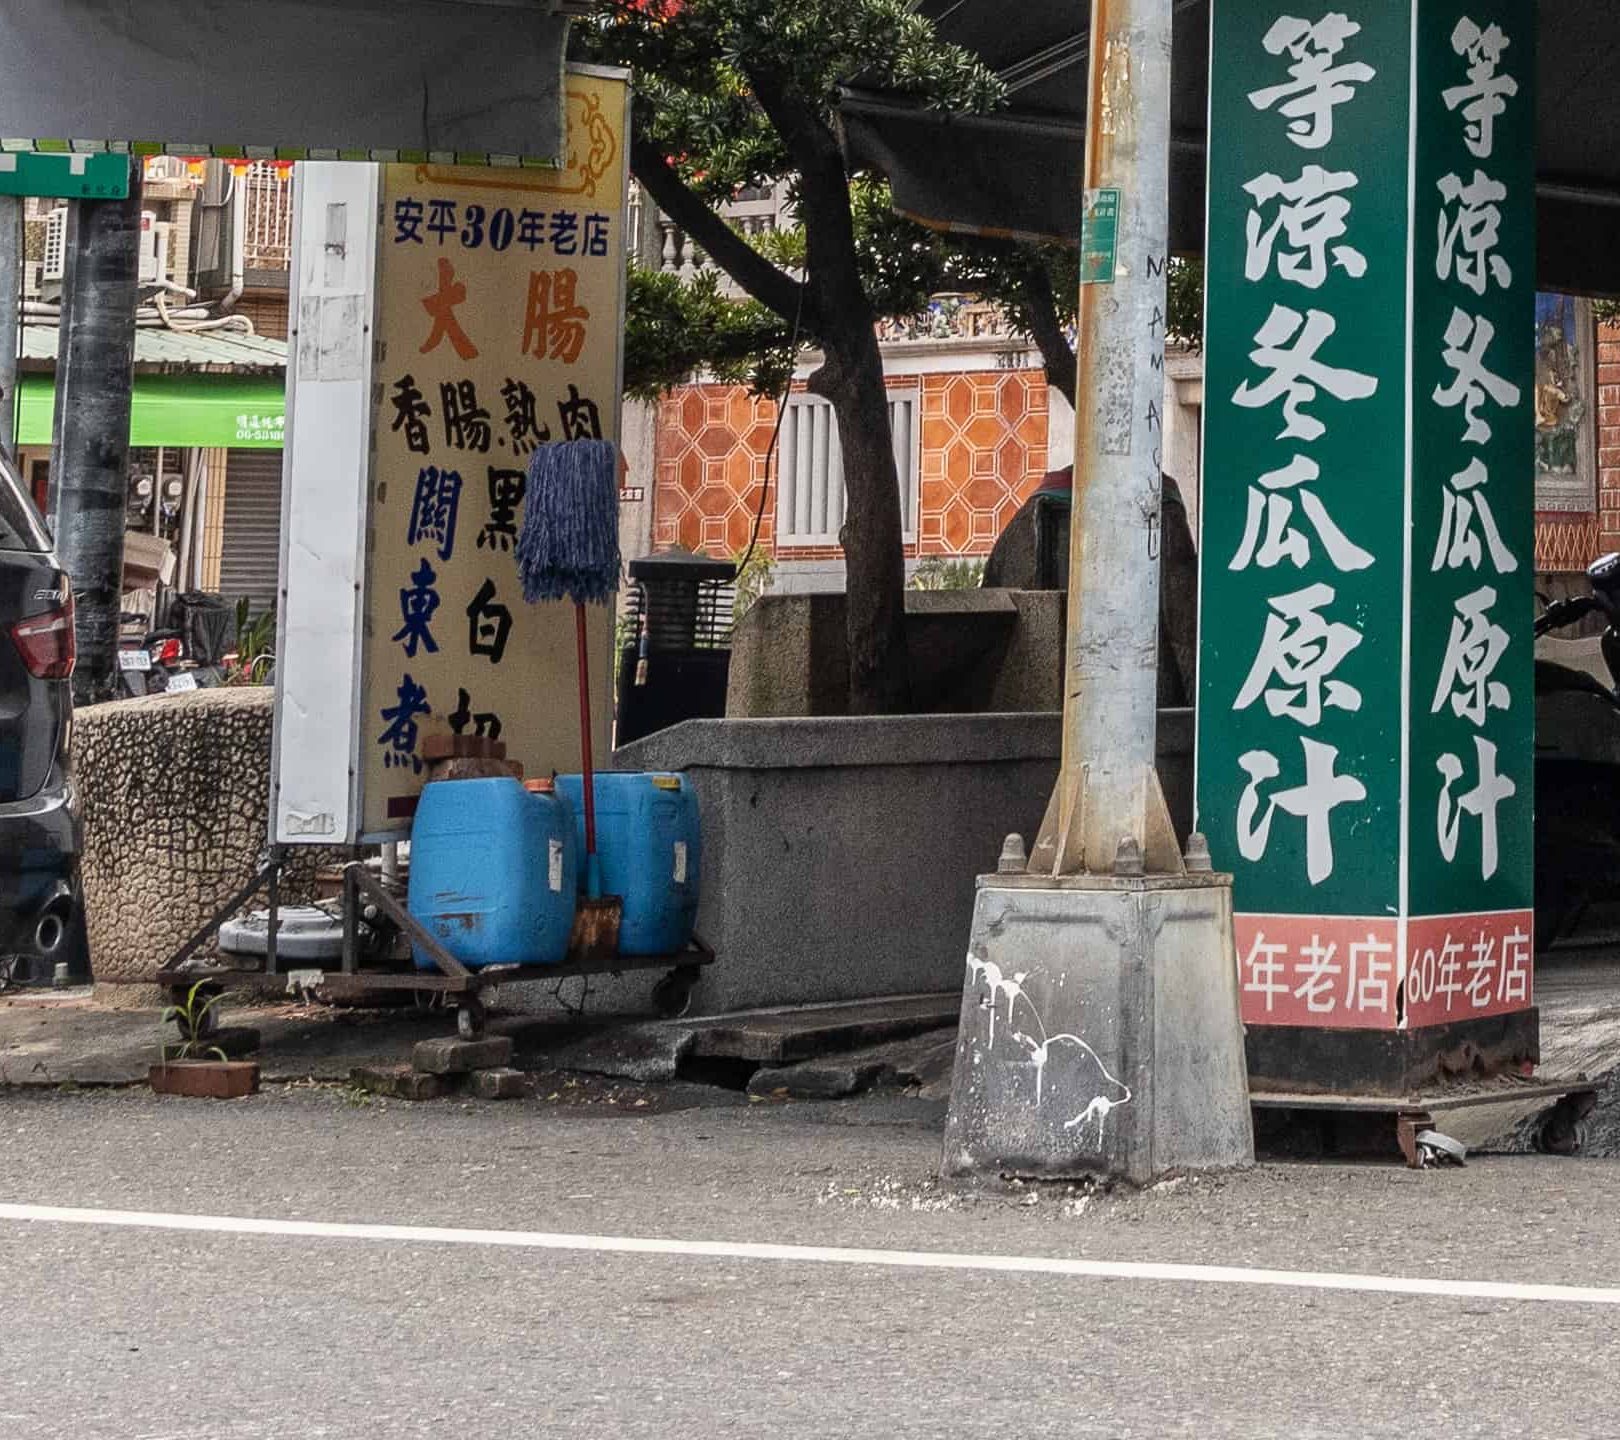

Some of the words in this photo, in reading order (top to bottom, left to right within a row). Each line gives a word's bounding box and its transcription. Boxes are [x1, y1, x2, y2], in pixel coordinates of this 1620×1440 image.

[392, 196, 611, 258] 安平30年老店
[377, 465, 464, 776] 關東煮
[1236, 930, 1394, 1014] 年老店
[1407, 924, 1531, 1013] 60年老店
